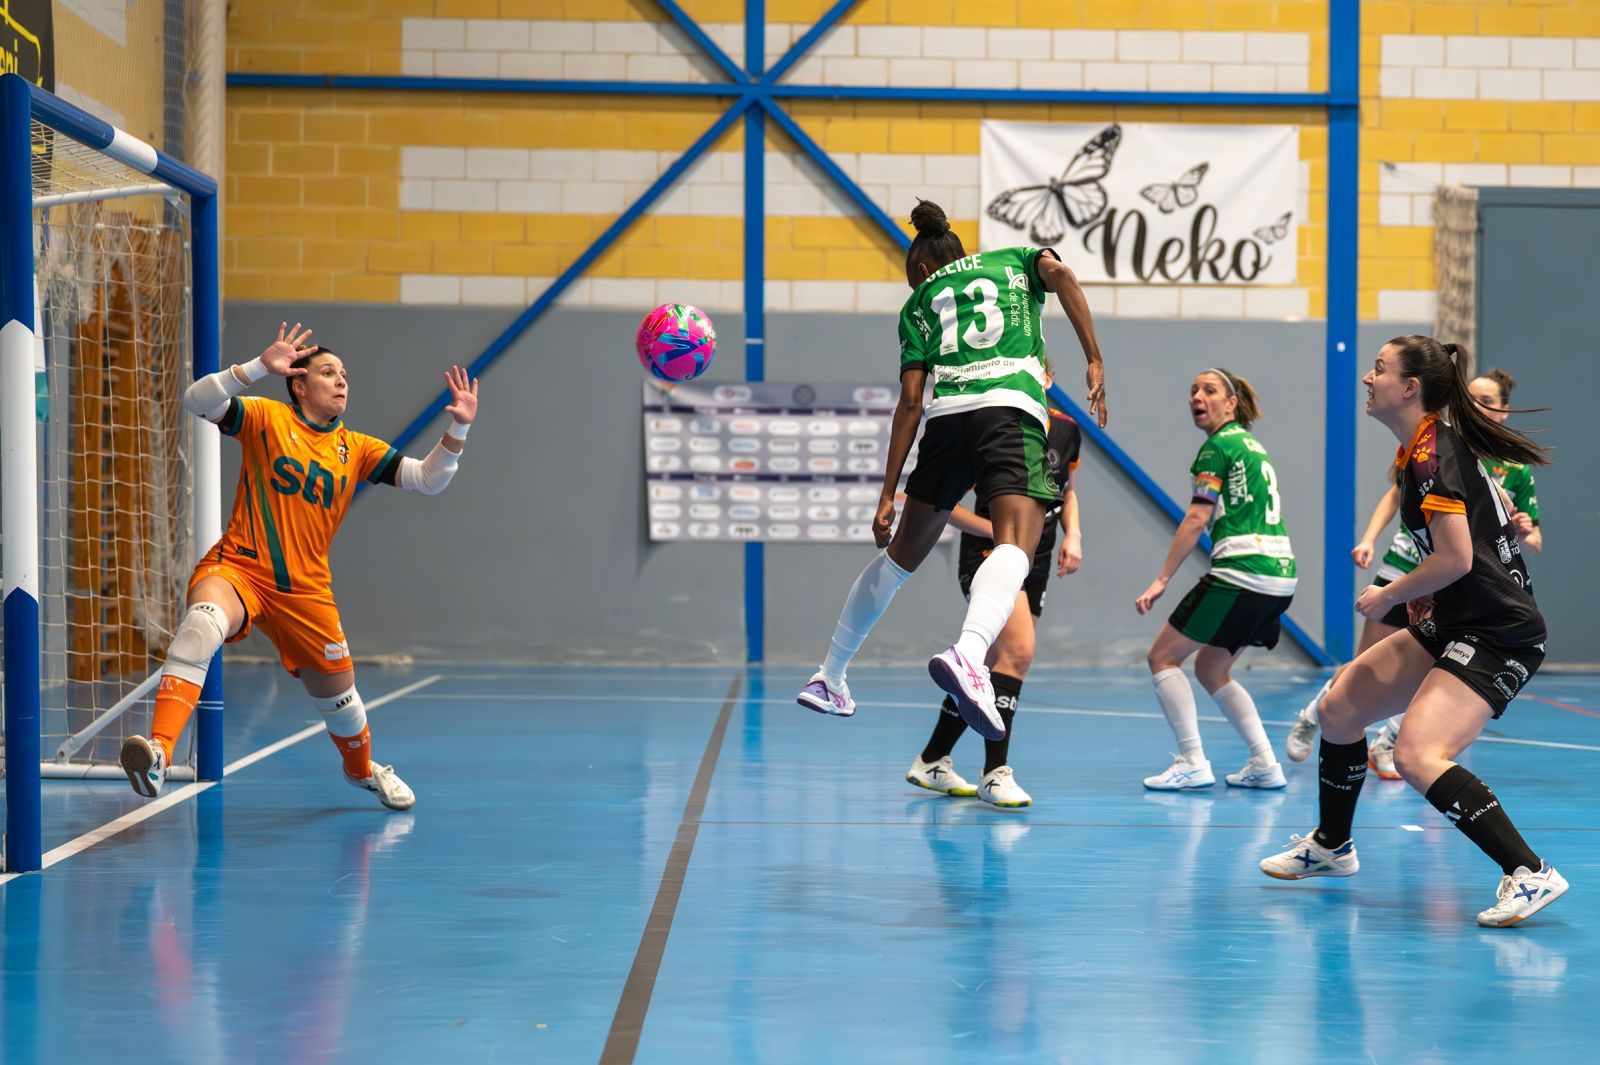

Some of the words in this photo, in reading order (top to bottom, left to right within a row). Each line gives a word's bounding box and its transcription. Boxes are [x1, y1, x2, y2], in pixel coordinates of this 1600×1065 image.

[1083, 204, 1272, 282] Neko
[930, 277, 1004, 355] 13
[1008, 292, 1018, 303] de
[1010, 304, 1020, 327] Cádiz
[1021, 292, 1031, 337] Diputación
[1261, 461, 1281, 526] 3
[1469, 800, 1499, 822] KELME
